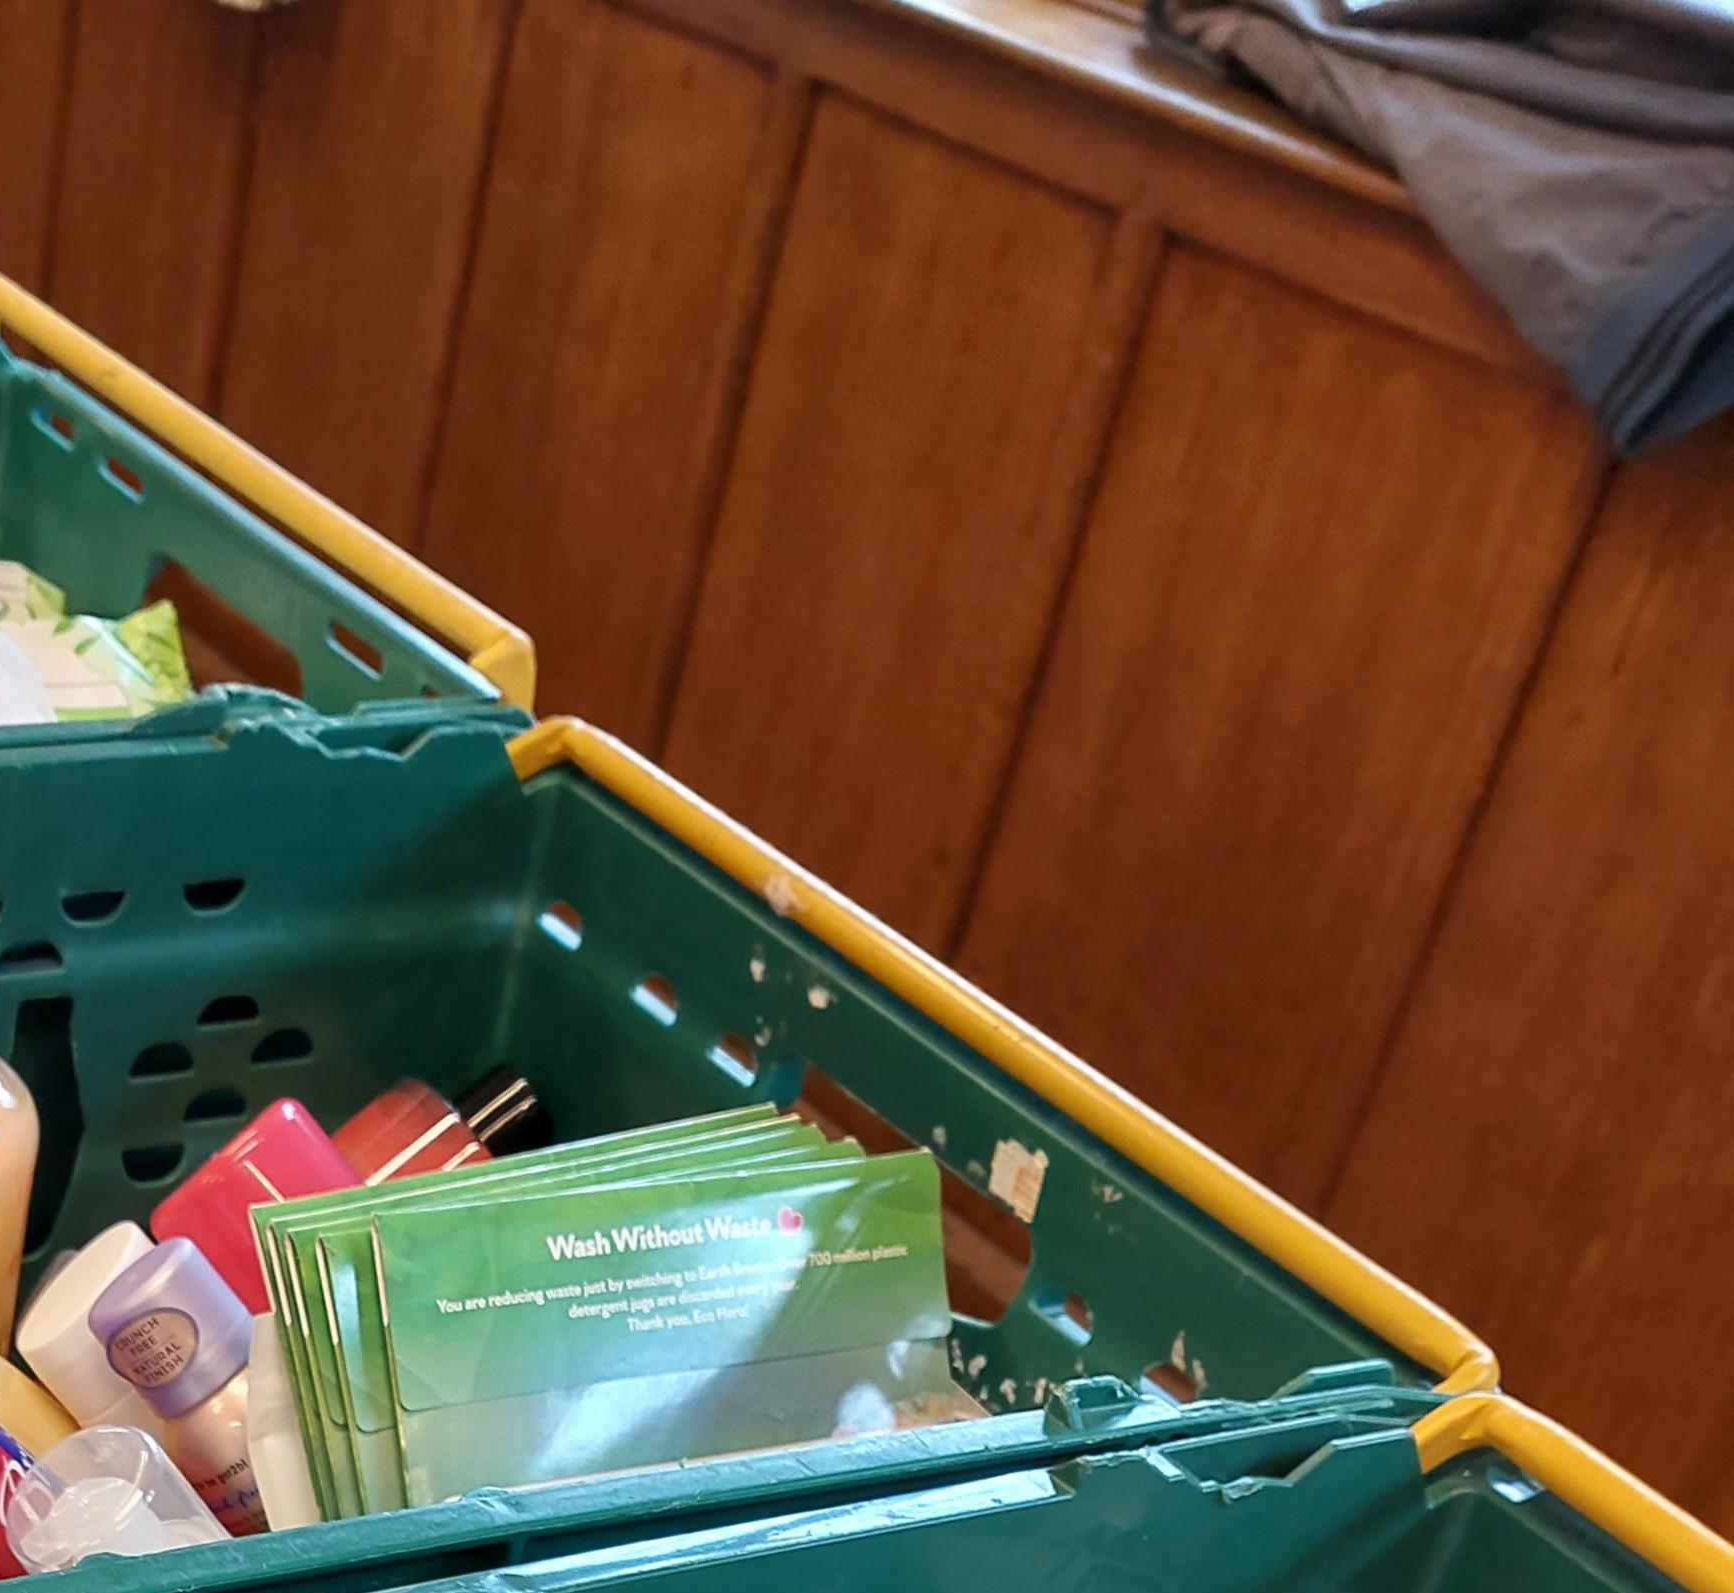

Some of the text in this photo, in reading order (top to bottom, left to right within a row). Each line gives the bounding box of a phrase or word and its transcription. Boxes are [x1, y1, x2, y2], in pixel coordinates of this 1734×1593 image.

[546, 1216, 771, 1261] Wash Without Waste
[436, 1299, 462, 1314] You
[465, 1298, 486, 1310] are
[488, 1289, 545, 1308] reducing
[546, 1286, 581, 1300] waste
[584, 1281, 607, 1297] just
[608, 1279, 623, 1294] by
[626, 1272, 682, 1291] switching
[685, 1271, 697, 1282] to
[699, 1264, 730, 1280] Earth
[834, 1249, 871, 1264] million
[569, 1299, 628, 1319] detergent
[630, 1295, 655, 1313] jugs
[658, 1294, 676, 1306] are
[679, 1286, 735, 1304] discarded
[116, 1317, 159, 1351] CRUNCH
[628, 1318, 663, 1332] Thank
[693, 1310, 714, 1323] Eco
[130, 1337, 158, 1357] FREE
[133, 1343, 181, 1375] NATURAL
[144, 1355, 183, 1383] FINISH
